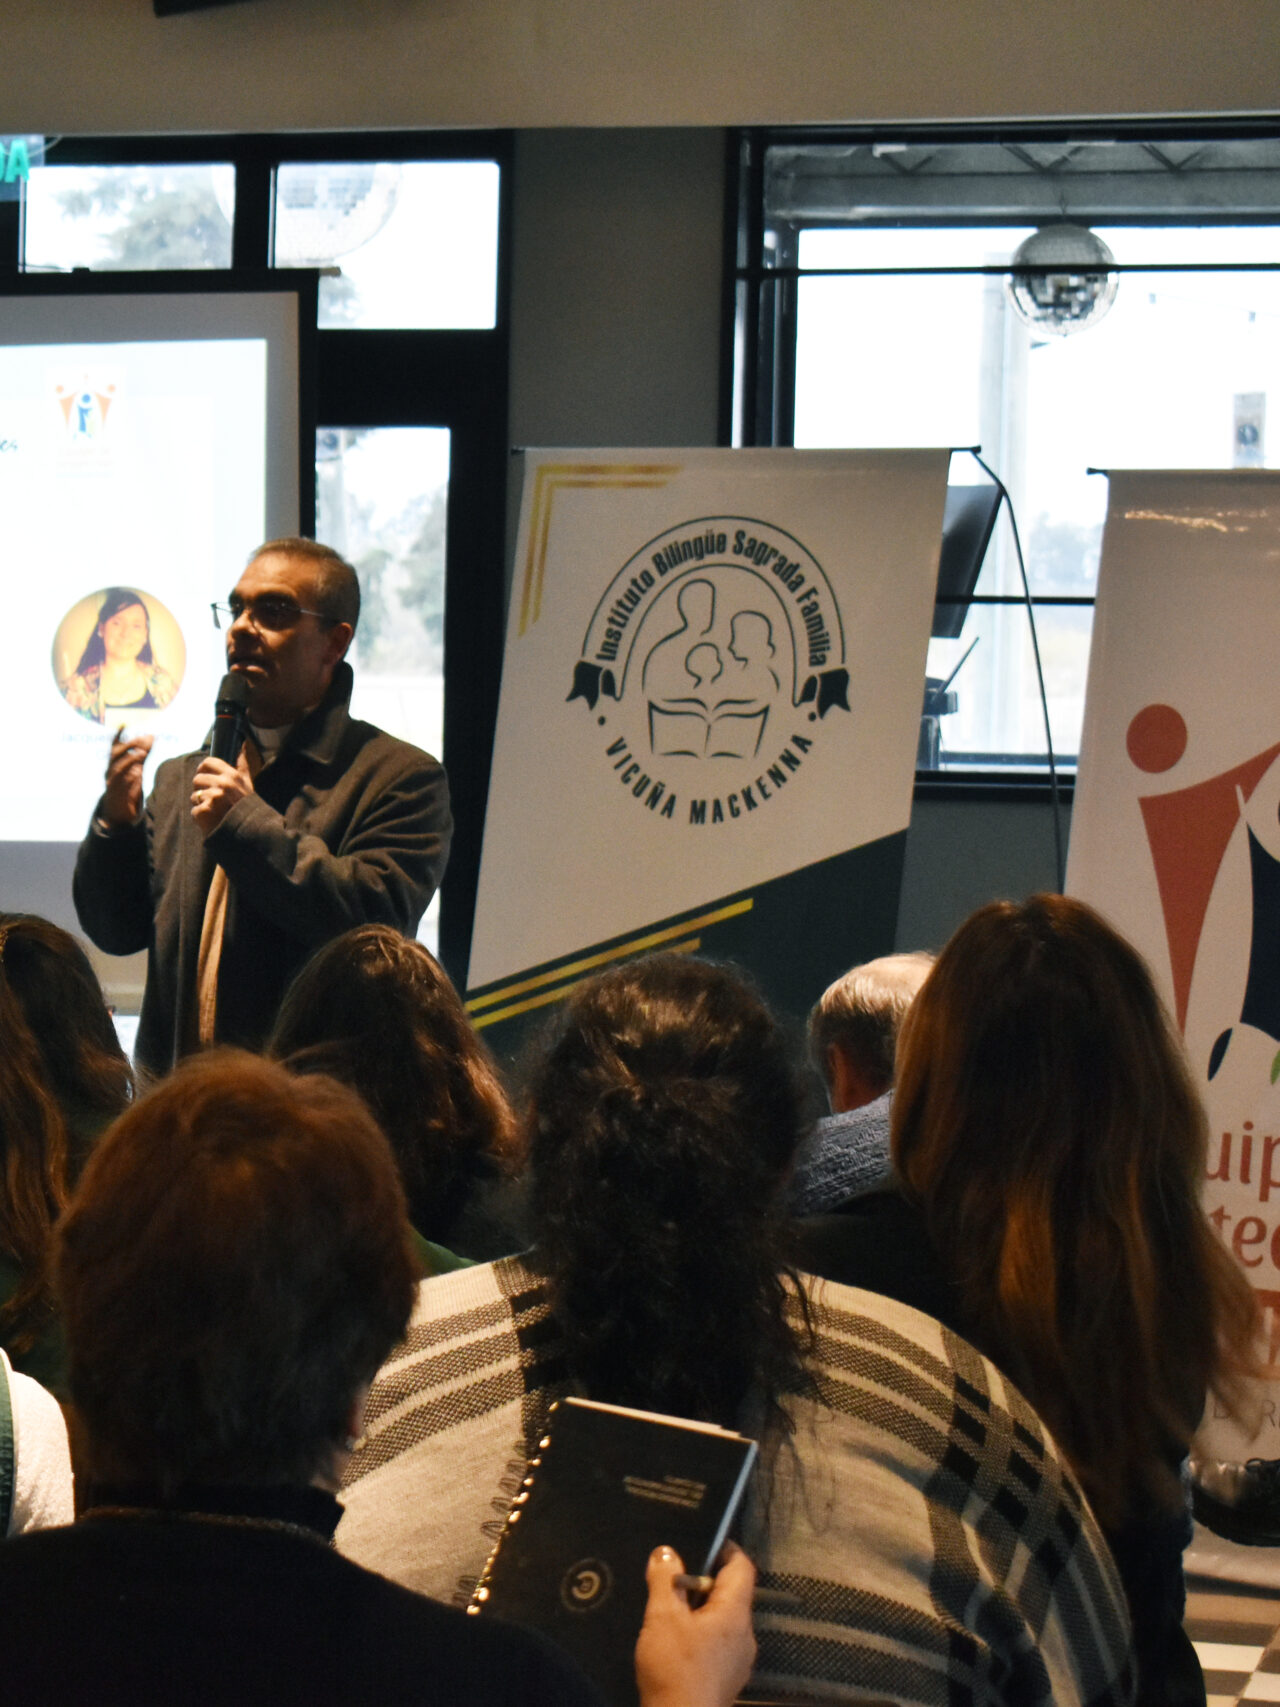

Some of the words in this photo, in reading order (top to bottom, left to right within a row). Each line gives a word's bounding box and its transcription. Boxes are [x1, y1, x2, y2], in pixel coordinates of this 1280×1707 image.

[595, 568, 656, 662] Instituto
[650, 528, 729, 578] Bilingüe
[732, 528, 807, 594] Sagrada
[794, 586, 833, 668] Familia
[605, 736, 677, 819] VICUÑA
[689, 734, 814, 825] MACKENNA
